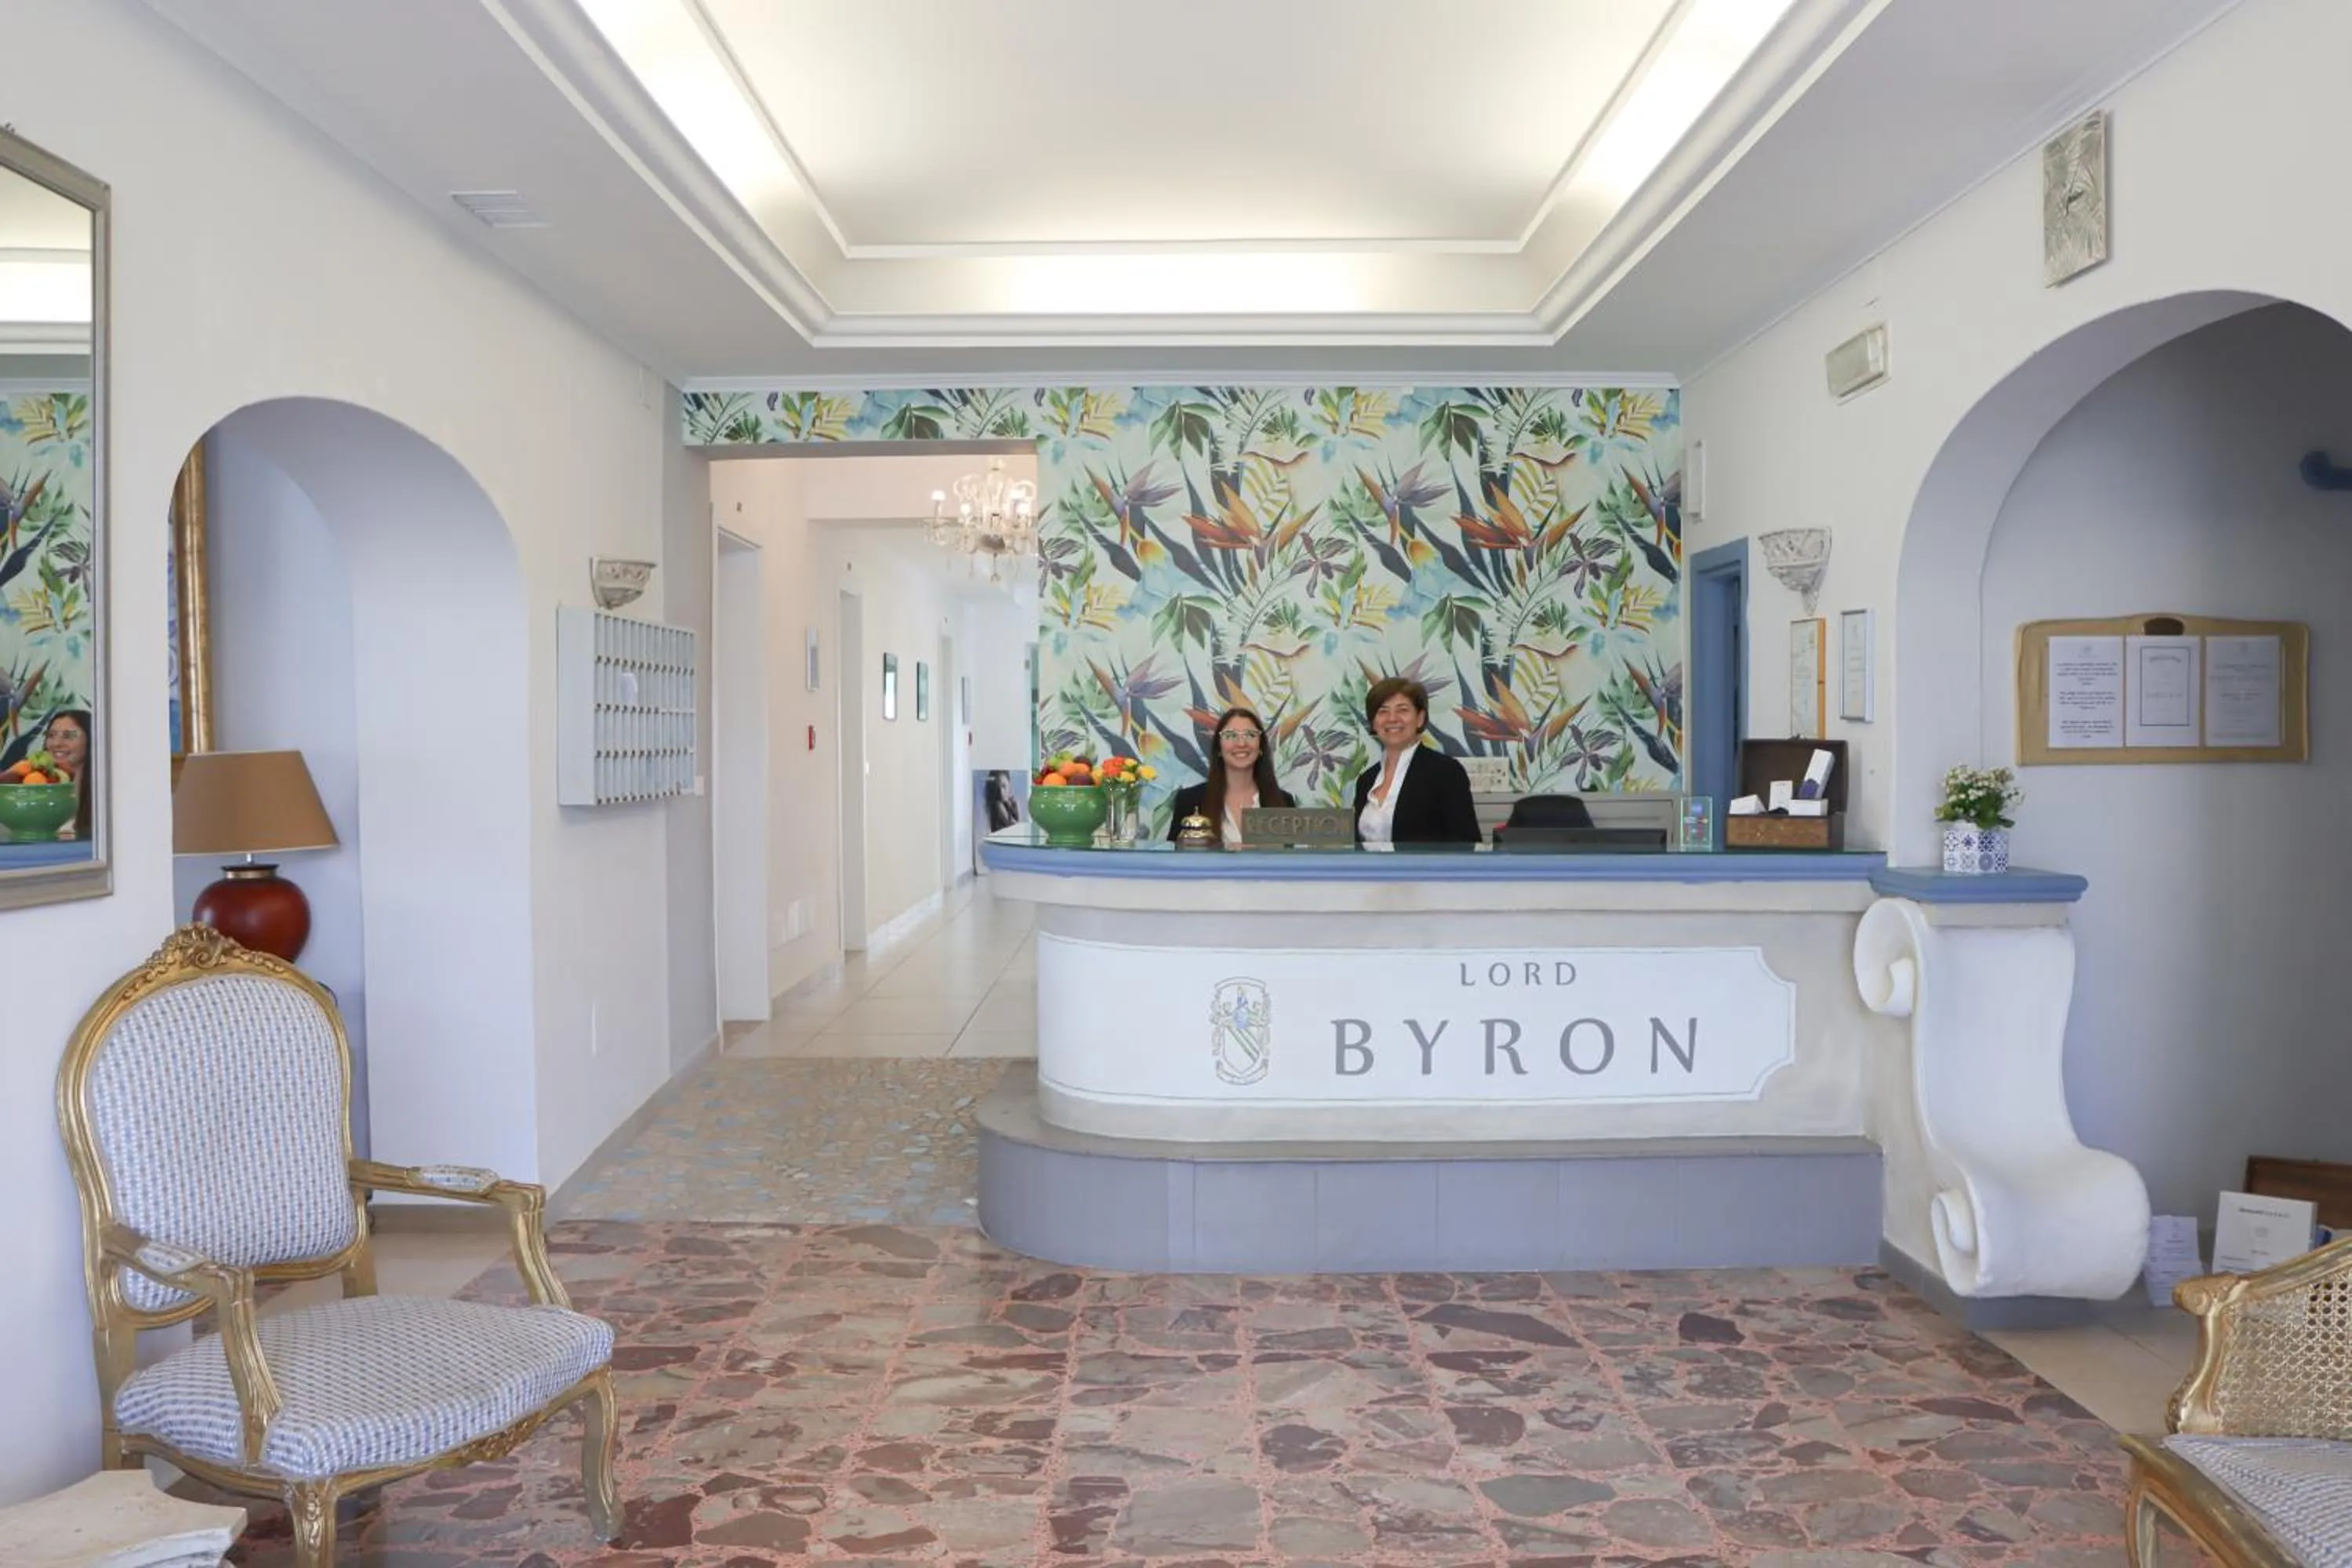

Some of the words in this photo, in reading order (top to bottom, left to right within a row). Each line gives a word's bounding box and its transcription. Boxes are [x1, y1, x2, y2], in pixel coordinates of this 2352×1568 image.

[1245, 815, 1350, 836] RECEPTION
[1460, 962, 1577, 986] LORD
[1330, 1016, 1698, 1076] BYRON
